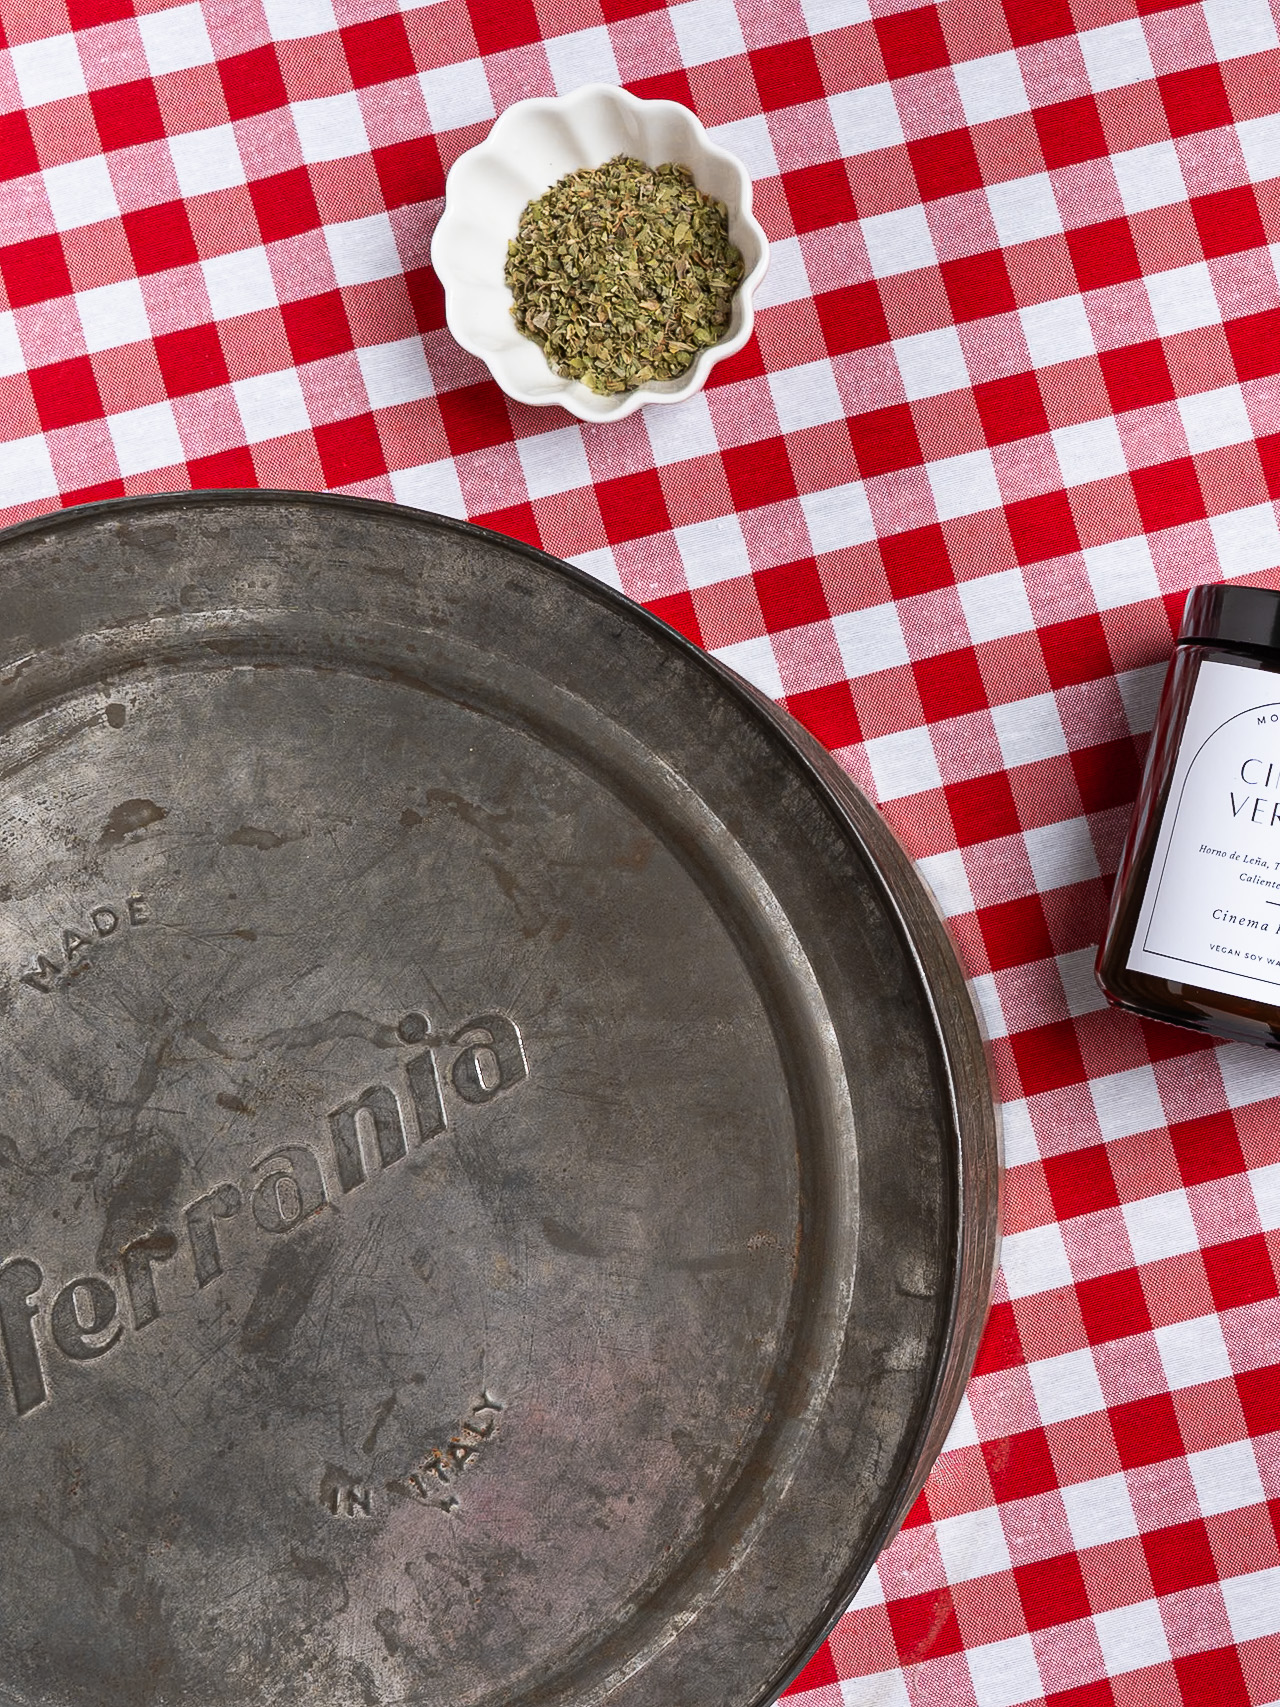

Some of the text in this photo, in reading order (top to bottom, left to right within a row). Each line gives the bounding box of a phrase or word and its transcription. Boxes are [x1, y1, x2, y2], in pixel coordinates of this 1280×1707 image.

[1198, 844, 1227, 858] Horno
[1229, 850, 1241, 862] de
[1242, 854, 1270, 869] Leña,
[1239, 872, 1280, 891] Caliente
[1211, 908, 1269, 932] Cinema
[19, 894, 151, 994] MADE
[1209, 943, 1242, 958] VEGAN
[1244, 951, 1264, 963] SOY
[0, 1010, 530, 1416] ferrania
[327, 1389, 503, 1518] IN ITALY
